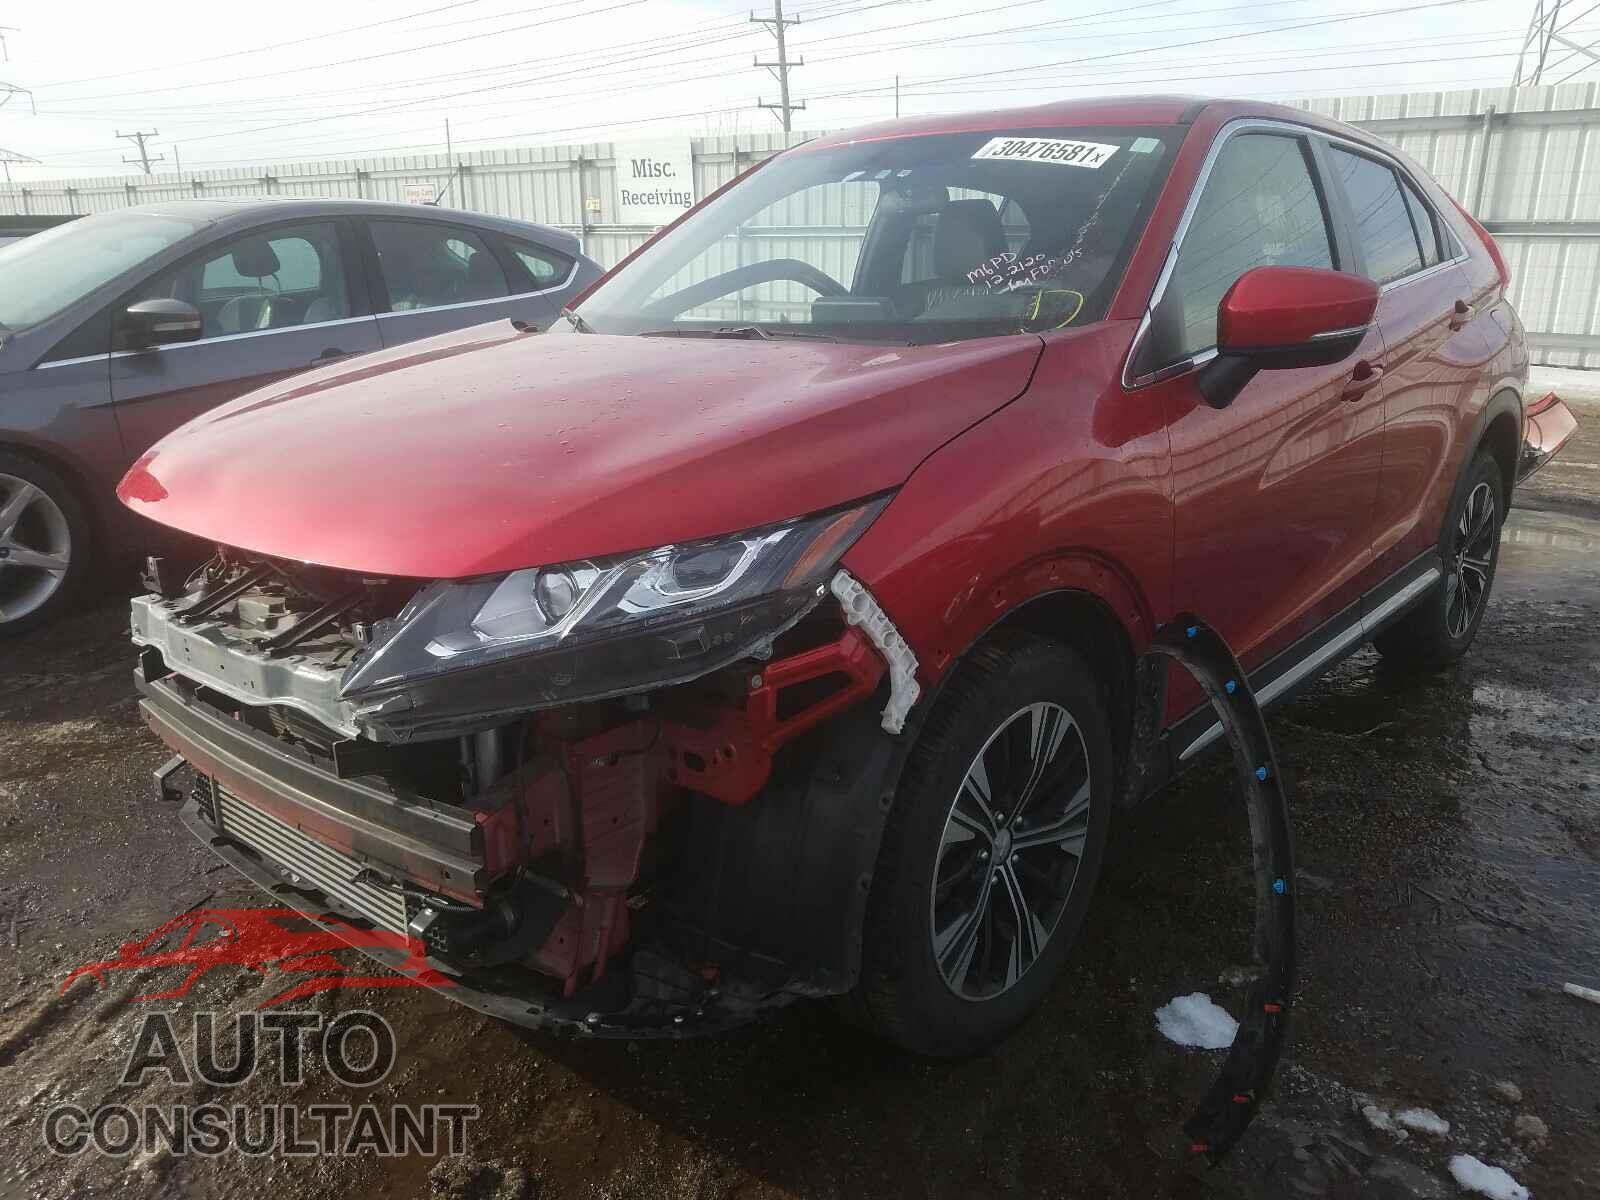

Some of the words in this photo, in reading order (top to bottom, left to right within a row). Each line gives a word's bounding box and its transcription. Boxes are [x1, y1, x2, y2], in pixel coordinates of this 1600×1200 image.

[992, 140, 1097, 163] 30476581
[631, 158, 676, 178] Misc.
[621, 188, 692, 209] Receiving
